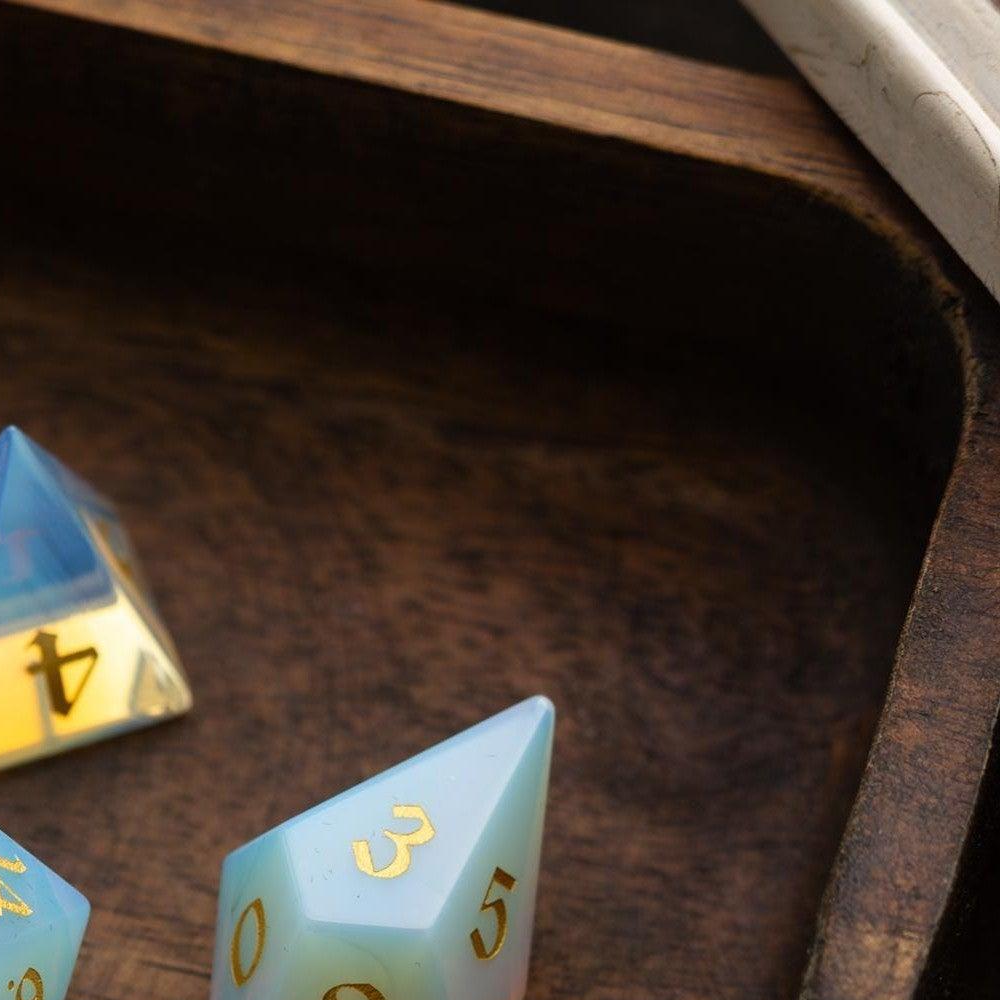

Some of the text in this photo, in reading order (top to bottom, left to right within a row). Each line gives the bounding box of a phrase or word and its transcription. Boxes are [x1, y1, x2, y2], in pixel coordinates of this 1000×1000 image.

[25, 630, 98, 719] 4
[352, 804, 435, 879] 3
[231, 898, 266, 988] 0
[470, 866, 517, 961] 5
